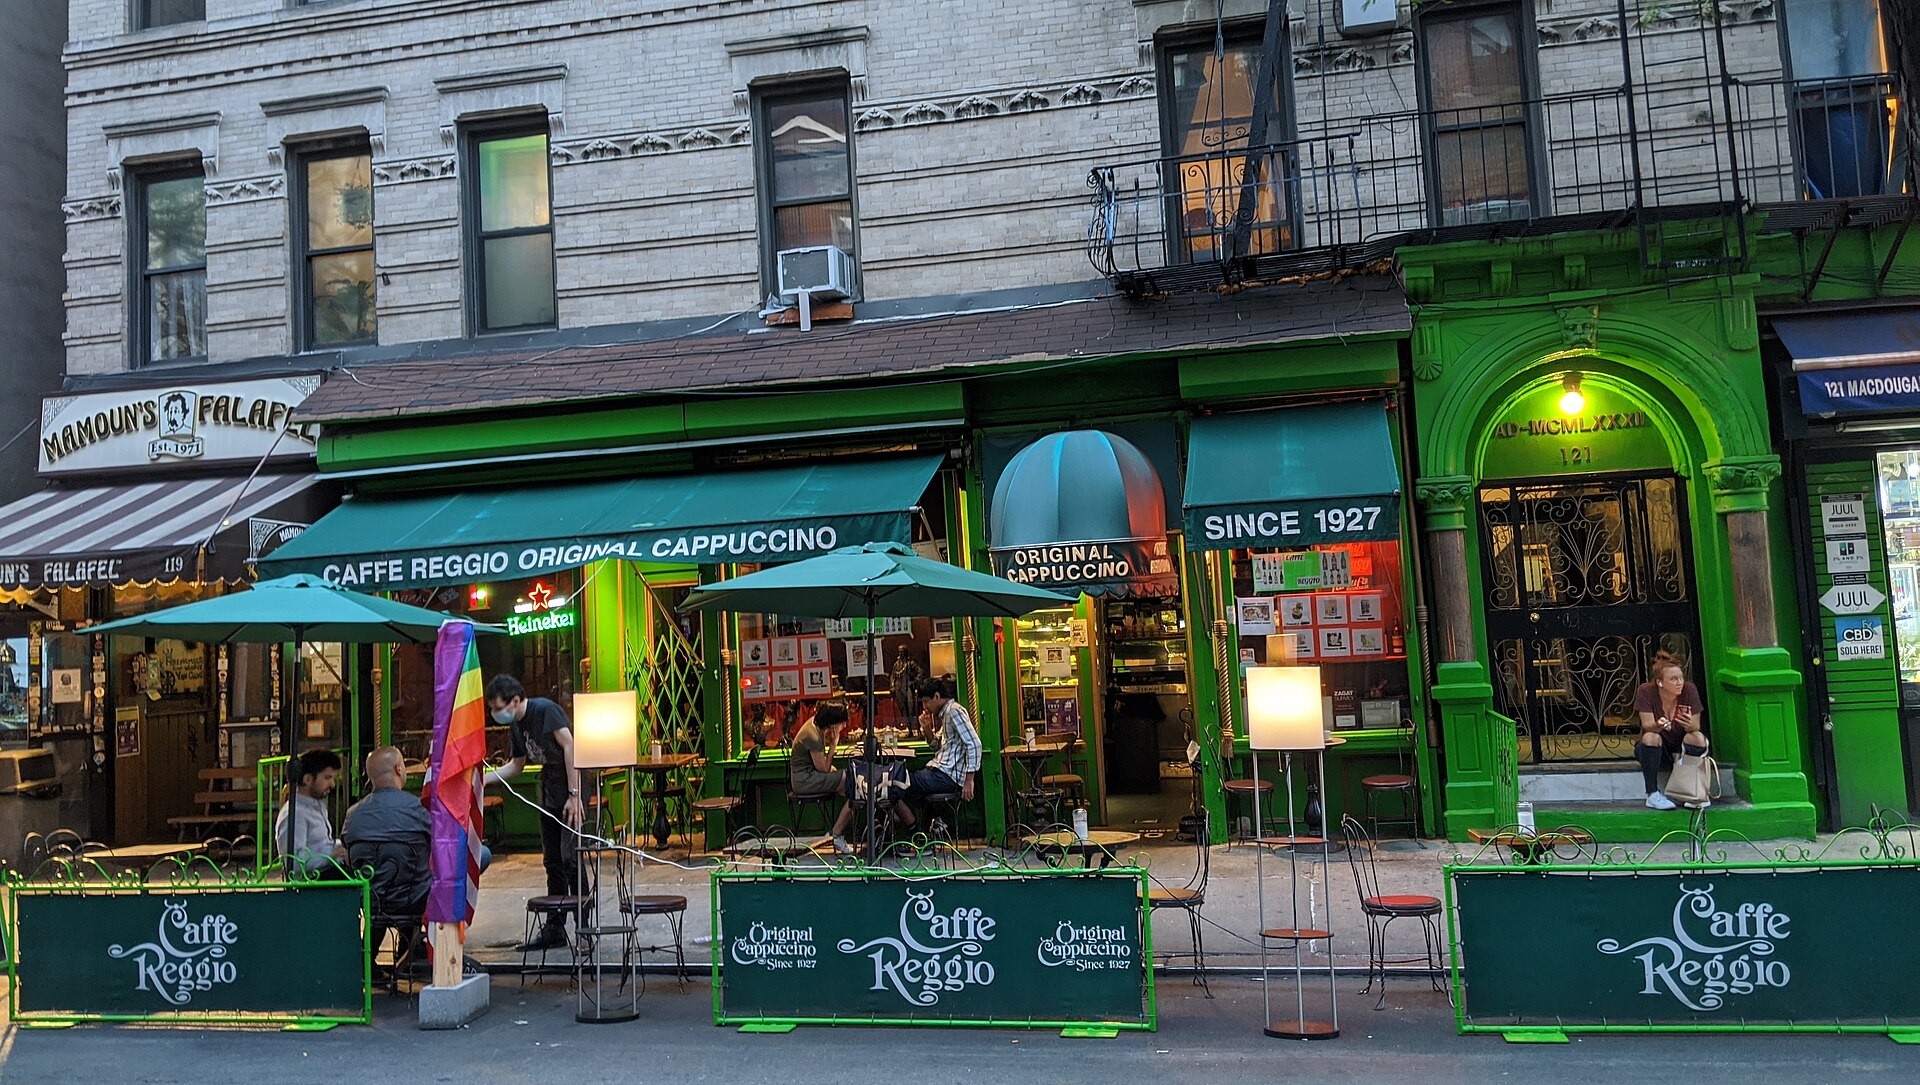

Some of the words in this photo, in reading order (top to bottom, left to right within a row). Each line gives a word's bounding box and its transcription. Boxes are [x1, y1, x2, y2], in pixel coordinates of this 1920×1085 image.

[1824, 381, 1844, 398] 121
[1847, 375, 1920, 398] MACDOUGA
[42, 400, 158, 463] MAMOUN'S
[151, 443, 171, 454] Est.
[174, 442, 201, 455] 1971
[1560, 446, 1592, 466] 121
[1832, 503, 1854, 515] JUUL
[1204, 510, 1300, 540] SINCE
[1314, 506, 1381, 534] 1927
[165, 557, 183, 573] 119
[322, 558, 403, 586] CAFFE
[410, 551, 509, 581] REGGIO
[518, 542, 643, 571] ORIGINAL
[651, 526, 837, 557] CAPPUCCINO
[1014, 544, 1114, 566] ORIGINAL
[1007, 561, 1129, 583] CAPPUCCINO
[1836, 591, 1870, 607] JUUL
[1843, 627, 1874, 642] CBD
[1840, 645, 1859, 656] SOLD
[1860, 644, 1882, 655] HERE!
[158, 898, 239, 958] Caffe
[900, 887, 997, 956] Caffe
[1672, 882, 1791, 955] Caffe
[749, 920, 813, 944] Original
[1056, 920, 1126, 944] Original
[731, 935, 817, 966] Cappuccino
[1037, 936, 1131, 967] Cappuccino
[107, 942, 237, 1006] Reggio
[767, 958, 793, 971] Since
[797, 959, 817, 969] 1927
[837, 936, 995, 1007] Reggio
[1076, 959, 1105, 972] Since
[1108, 960, 1131, 970] 1927
[1596, 936, 1791, 1011] Reggio
